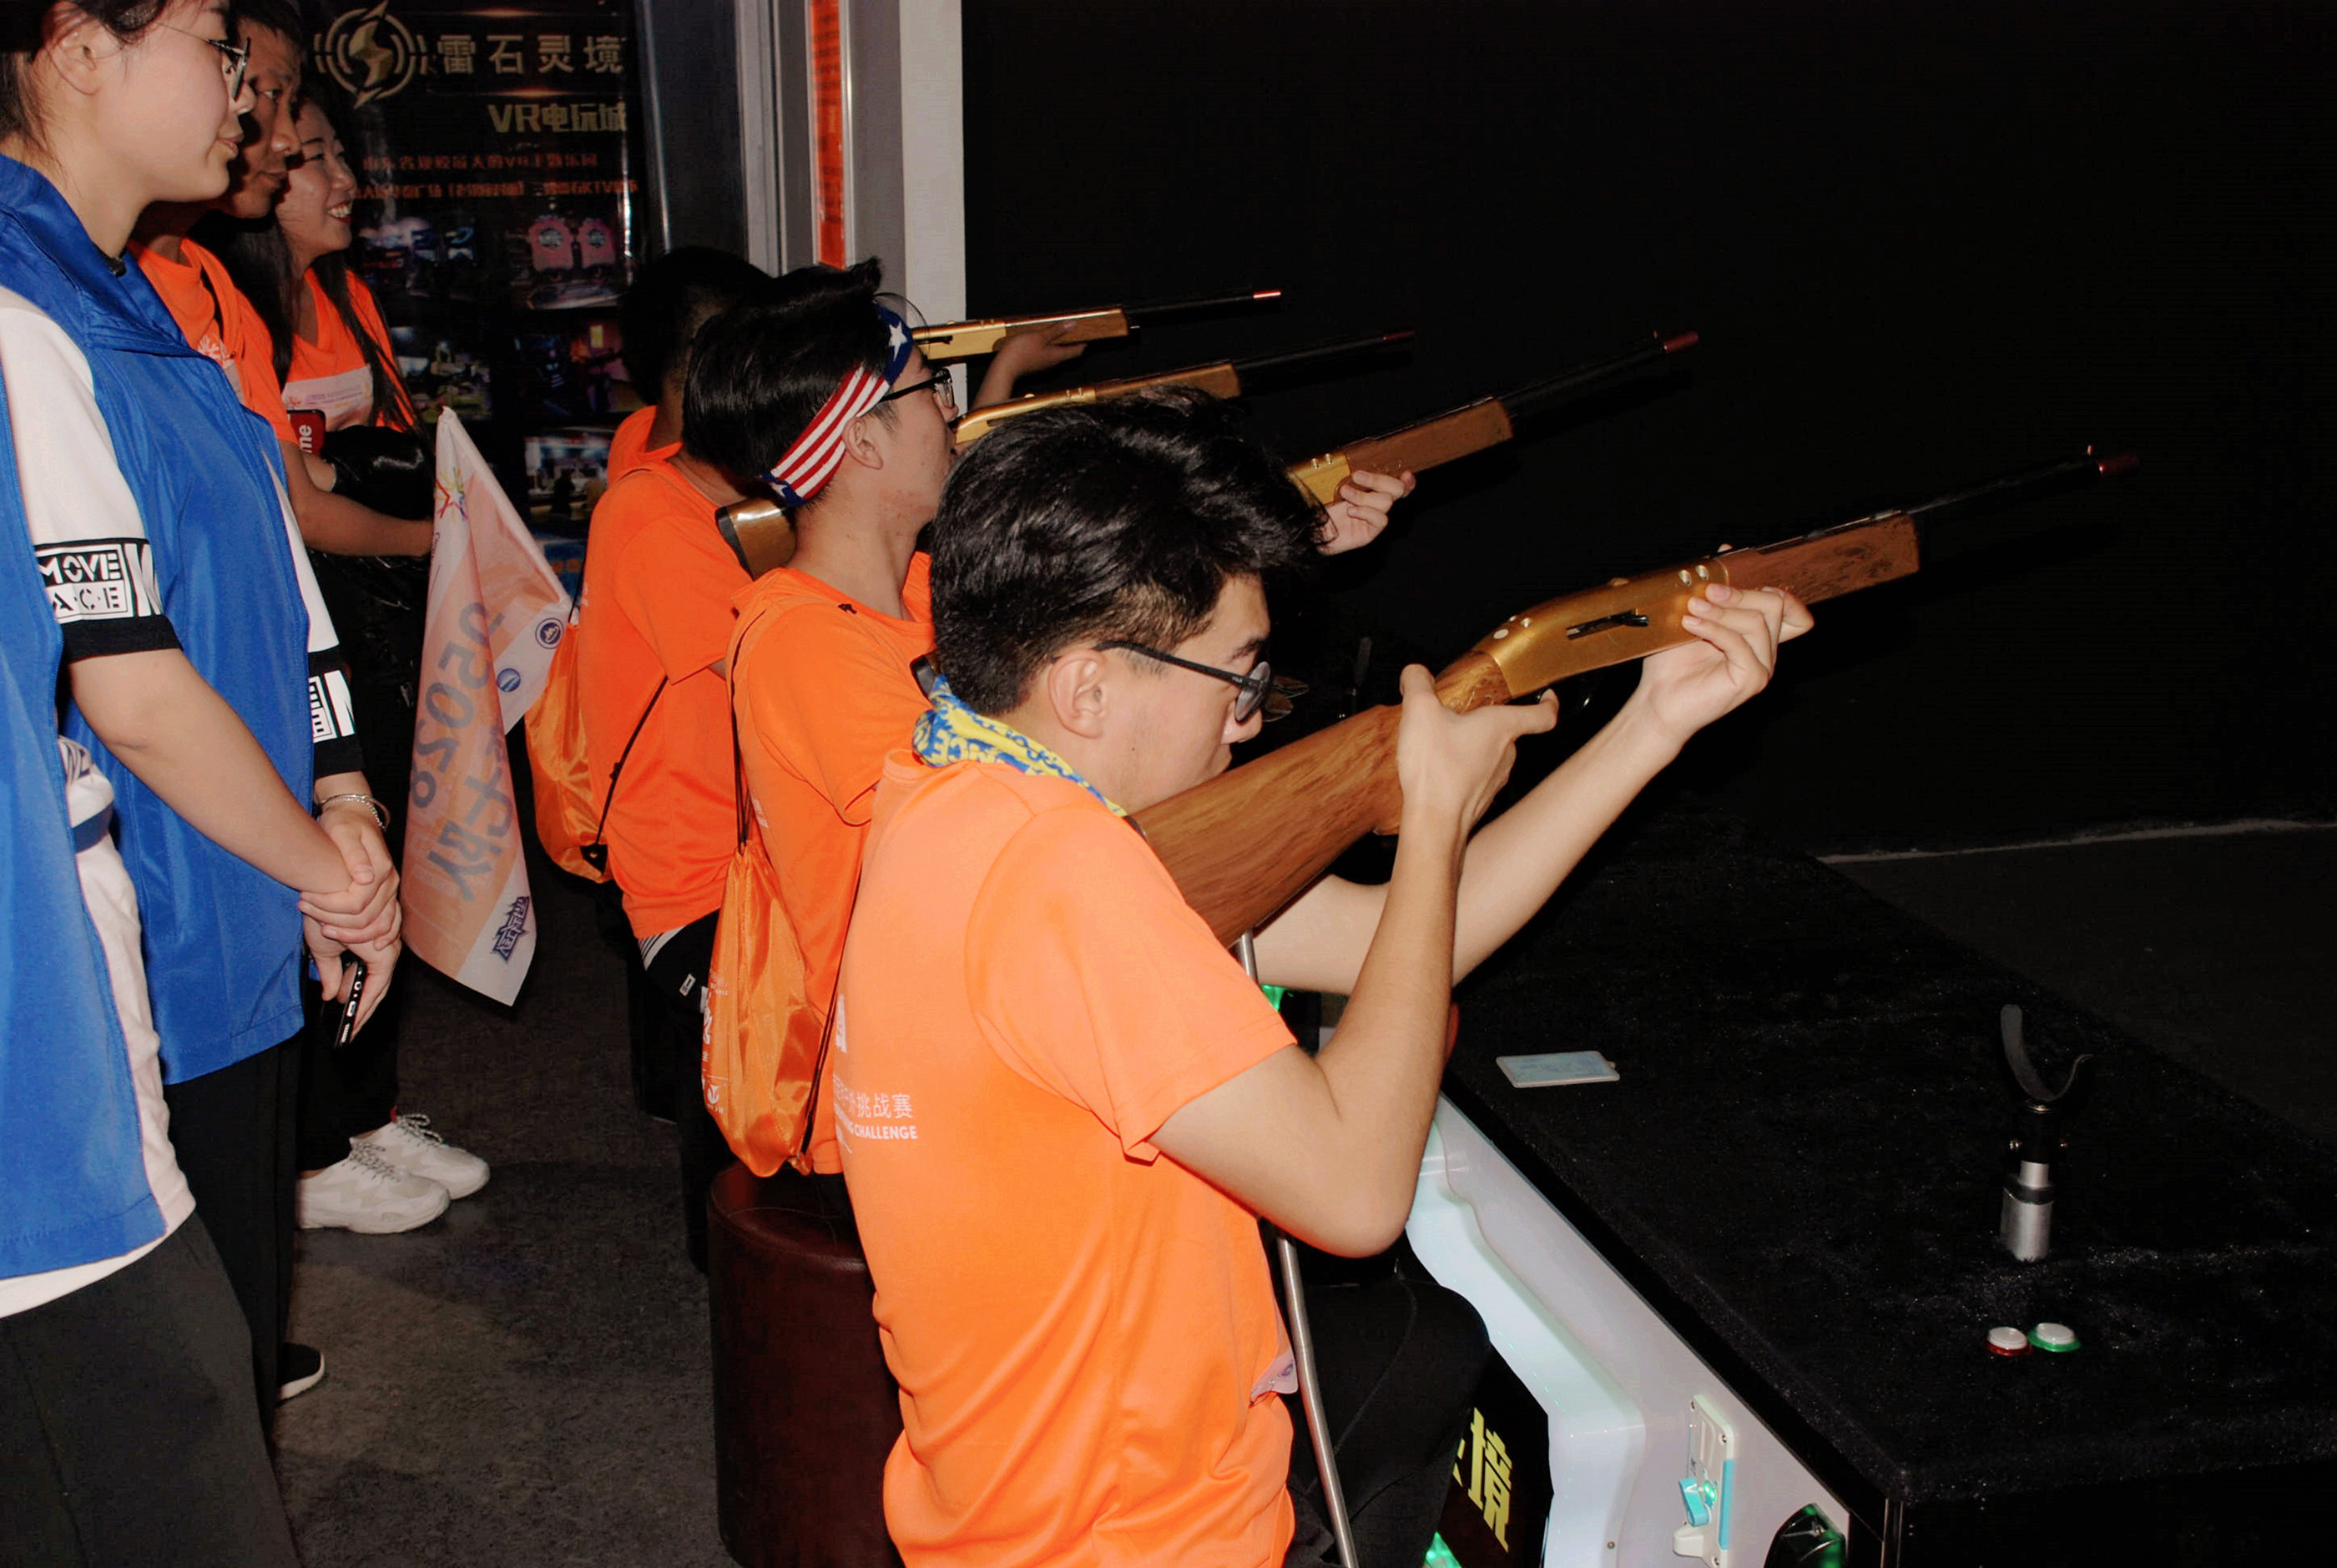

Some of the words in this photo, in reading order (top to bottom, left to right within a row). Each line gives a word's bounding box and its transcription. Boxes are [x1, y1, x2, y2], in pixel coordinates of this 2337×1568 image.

[437, 35, 626, 74] 雷石灵境
[487, 103, 627, 133] VR电玩城
[38, 552, 122, 584] MOVE
[854, 1123, 917, 1139] CHALLENGE
[1452, 1407, 1513, 1554] 境
